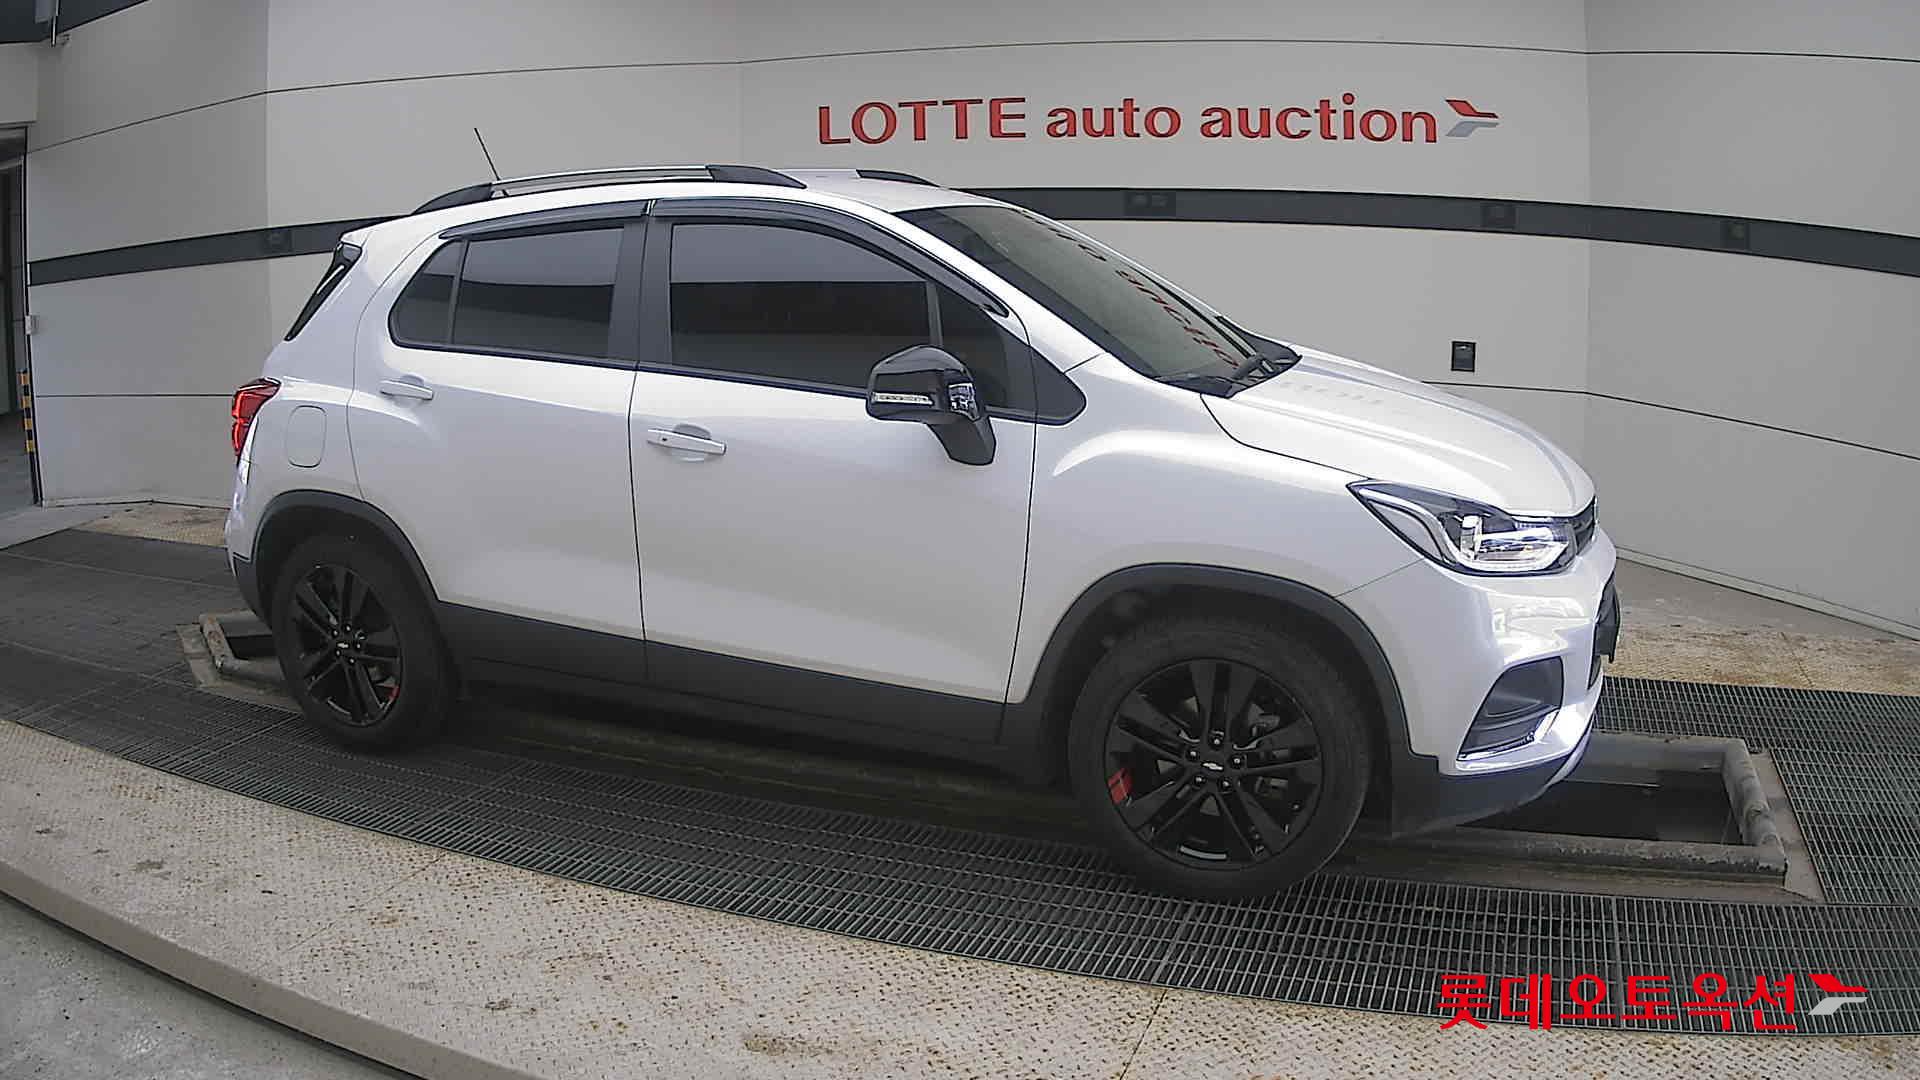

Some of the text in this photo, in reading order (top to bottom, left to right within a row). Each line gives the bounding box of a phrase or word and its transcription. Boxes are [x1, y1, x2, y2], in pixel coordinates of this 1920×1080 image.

[818, 93, 1438, 145] LOTTE auto auction
